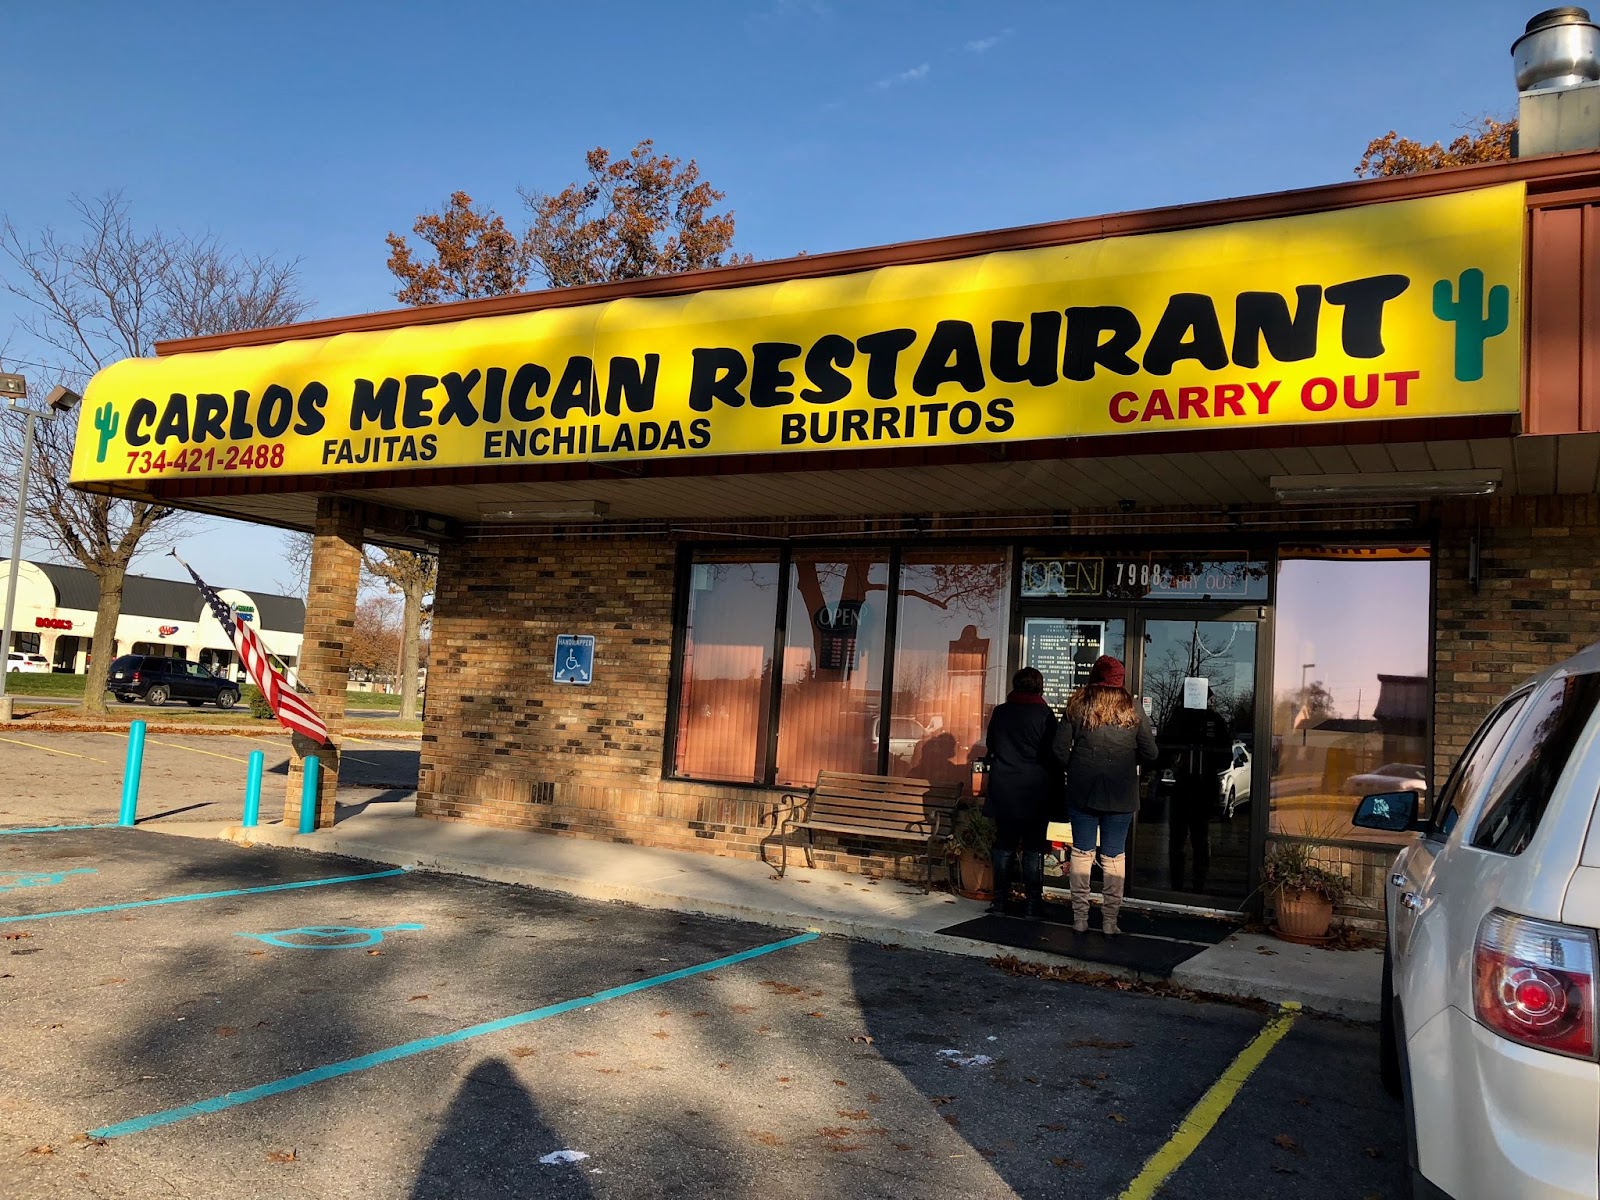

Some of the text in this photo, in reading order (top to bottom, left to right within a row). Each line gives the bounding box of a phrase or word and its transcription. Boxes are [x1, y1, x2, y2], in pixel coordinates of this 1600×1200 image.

[125, 274, 1410, 446] CARLOS MEXICAN RESTAURANT
[1108, 370, 1420, 424] CARRY OUT
[322, 398, 1015, 465] FAJITAS ENCHILADAS BURRITOS
[126, 443, 285, 475] 734-421-2488
[1028, 562, 1097, 591] OPEN
[1116, 563, 1161, 586] 7988
[1159, 574, 1235, 590] CARRY OUT
[35, 617, 73, 630] BOOKS
[820, 607, 861, 626] OPEN
